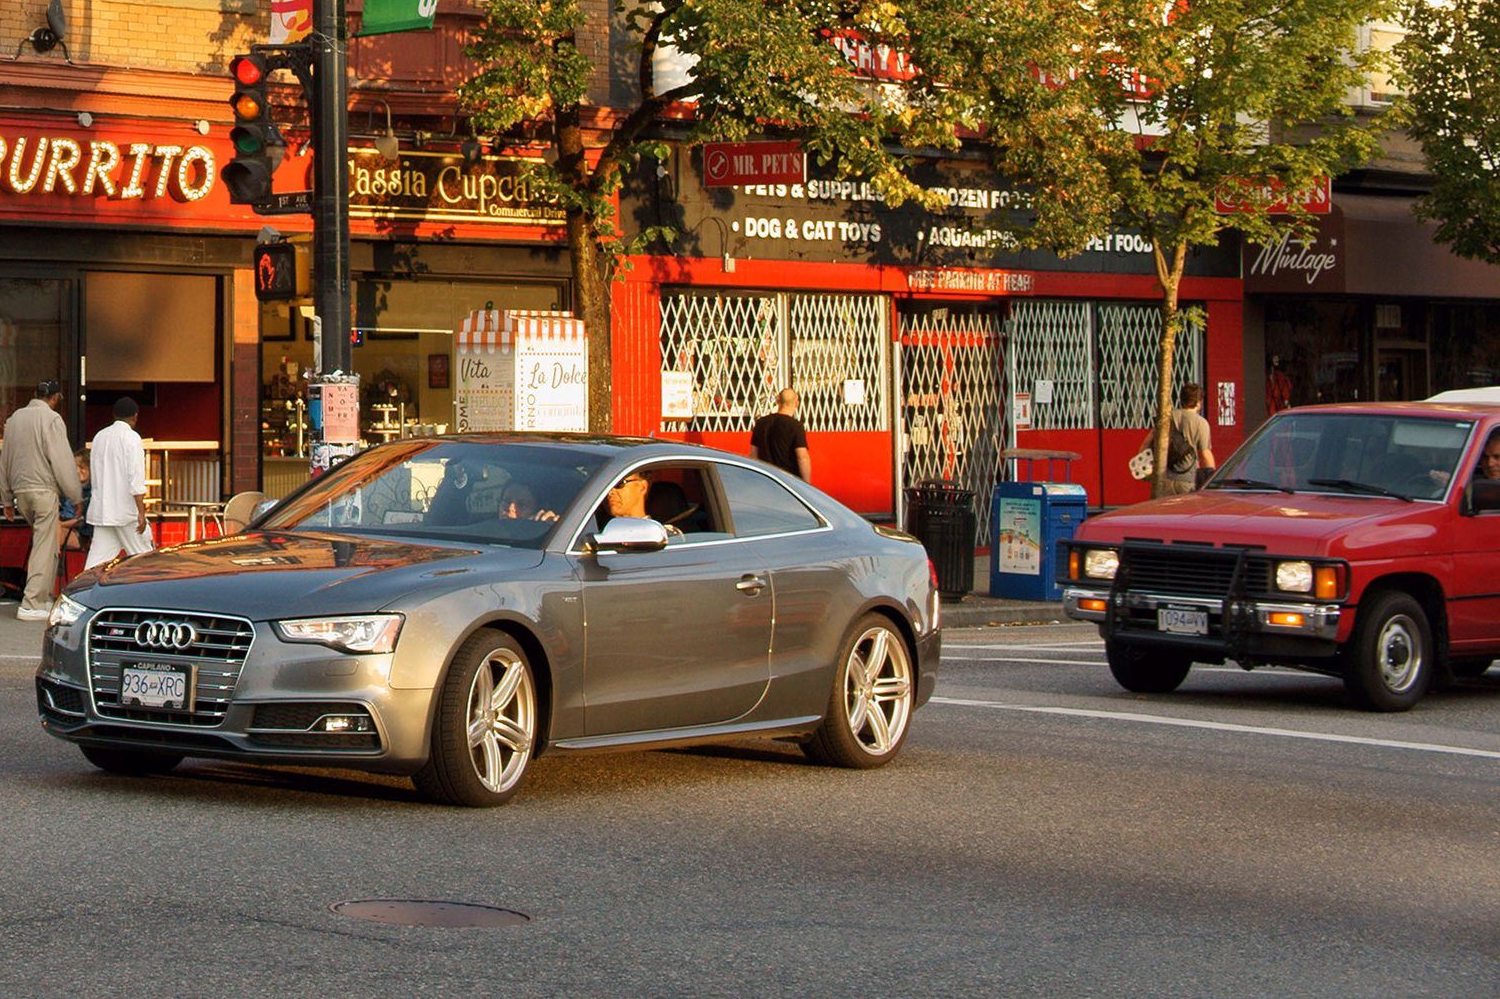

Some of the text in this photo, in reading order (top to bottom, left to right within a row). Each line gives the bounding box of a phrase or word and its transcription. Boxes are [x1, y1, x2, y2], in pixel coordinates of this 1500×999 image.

[733, 153, 800, 175] MR. PET'S
[438, 166, 559, 213] Cupca
[490, 204, 541, 218] Commercial
[745, 217, 882, 243] DOG & CAT TOYS
[461, 358, 492, 383] Vita
[527, 362, 587, 390] La Dolce
[137, 662, 171, 671] CAPILANO
